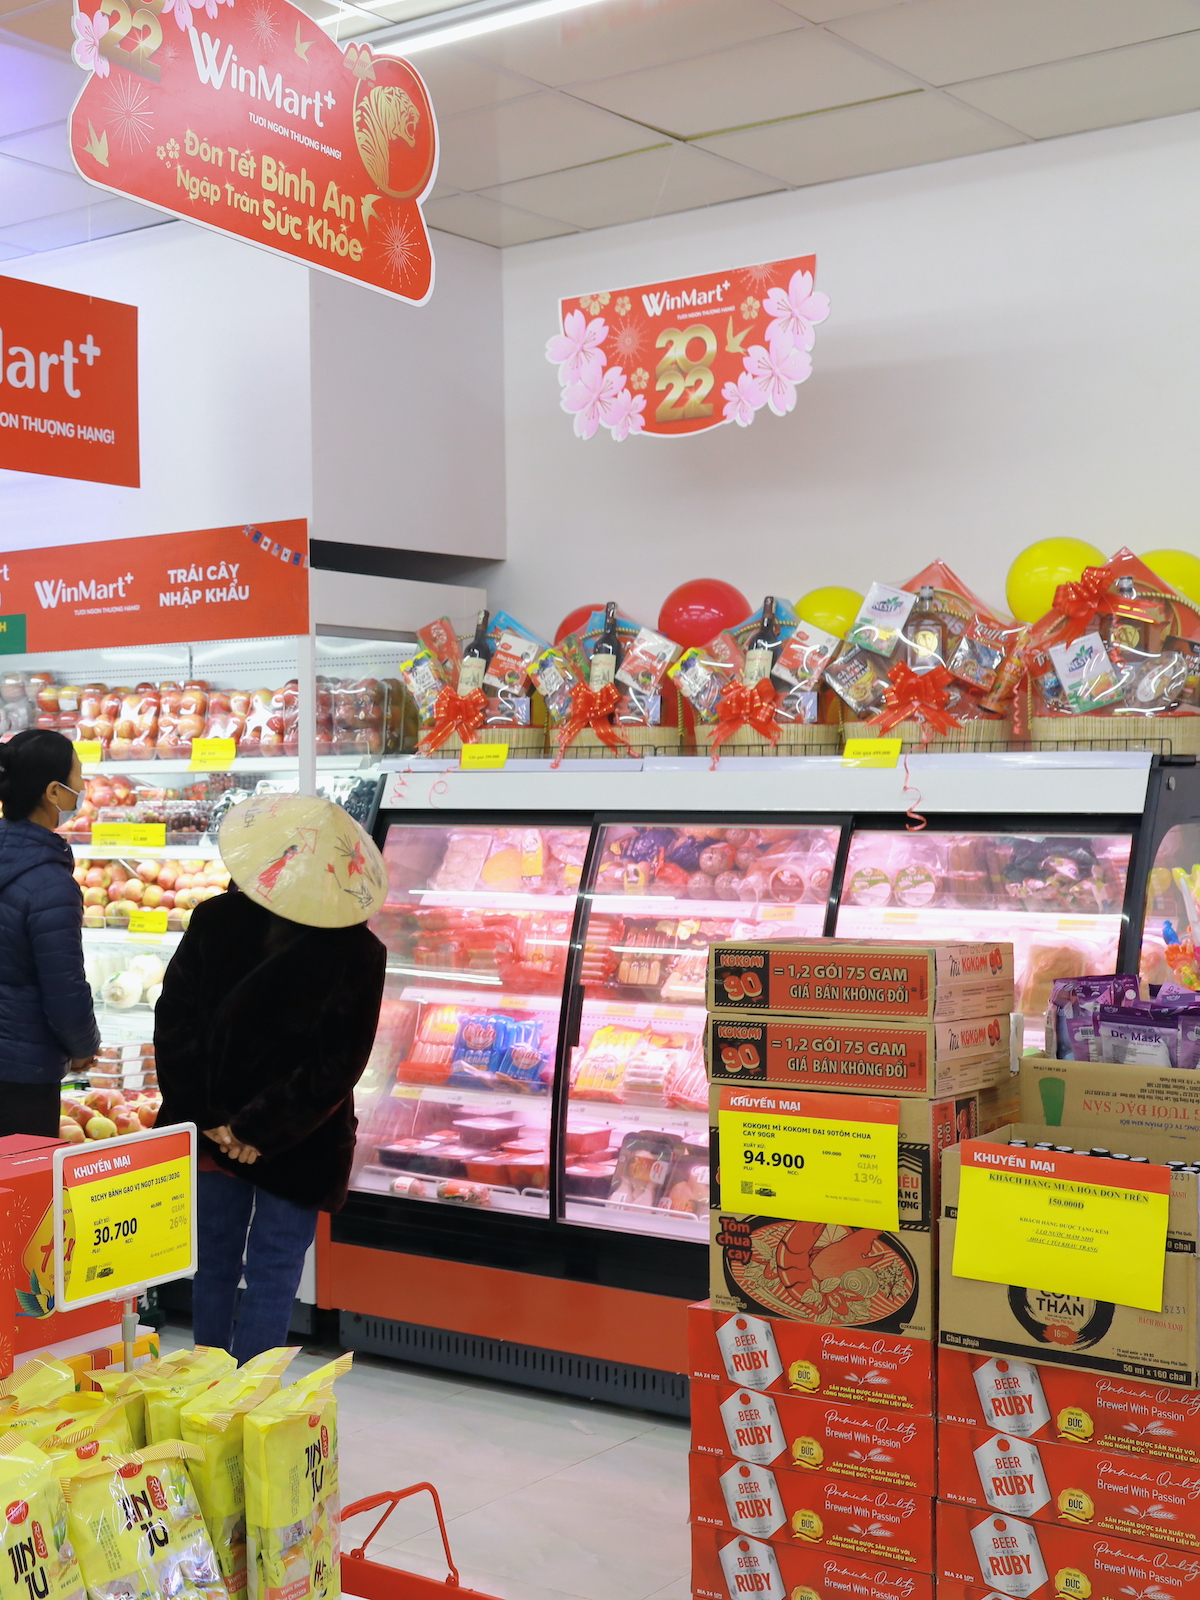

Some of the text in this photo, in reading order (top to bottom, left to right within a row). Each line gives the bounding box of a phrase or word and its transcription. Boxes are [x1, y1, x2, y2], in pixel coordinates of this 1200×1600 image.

[188, 26, 336, 128] WinMart+
[249, 112, 342, 161] TƯƠI NGON THƯỢNG HẠNG!
[184, 129, 355, 223] Đón Tết Bình An
[176, 165, 364, 262] Ngập Tràn Sức Khỏe
[641, 280, 731, 317] WinMart+
[655, 366, 715, 424] 22
[22, 415, 75, 439] THƯỢNG
[78, 425, 115, 445] HẠNG!
[167, 561, 240, 584] TRÁI CÂY
[34, 572, 134, 609] WinMart+
[159, 579, 250, 608] NHẬP KHẨU
[720, 954, 764, 968] KOKOMI
[787, 963, 908, 982] 1,2 GÓI 75 GAM
[723, 971, 763, 1001] 90
[790, 982, 909, 1003] GIÁ BÁN KHÔNG ĐỔI
[718, 1026, 762, 1040] KOKOMI
[1111, 1030, 1161, 1044] Dr. Mask
[730, 1094, 801, 1112] KHUYẾN MẠI
[1083, 1099, 1111, 1115] SẢN
[742, 1122, 770, 1130] KOKOMI
[773, 1123, 781, 1131] MÌ
[783, 1125, 811, 1134] KOKOMI
[812, 1127, 825, 1136] ĐẠI
[827, 1128, 850, 1138] 90TÔM
[742, 1130, 756, 1138] CAY
[73, 1154, 131, 1179] KHUYẾN MẠI
[743, 1150, 805, 1169] 94.900
[974, 1151, 1056, 1173] KHUYẾN MẠI
[854, 1172, 882, 1185] 13%
[989, 1172, 1022, 1184] KHÁCH
[1024, 1178, 1051, 1189] HÀNG
[1054, 1183, 1075, 1192] MUA
[1077, 1185, 1097, 1196] HÓA
[1123, 1192, 1149, 1203] TRÊN
[94, 1217, 137, 1246] 30.700
[170, 1215, 187, 1230] 26%
[721, 1218, 750, 1234] Tôm
[717, 1233, 750, 1247] chua
[727, 1250, 750, 1262] cay
[1036, 1298, 1084, 1317] THAN
[1164, 1305, 1186, 1315] 5231
[735, 1334, 757, 1348] BEER
[821, 1332, 914, 1365] Premium Quality
[732, 1350, 770, 1372] RUBY
[821, 1350, 898, 1370] Brewed With Passion
[994, 1377, 1021, 1391] BEER
[1123, 1364, 1186, 1383] 50 ml x 160 chai
[991, 1393, 1034, 1418] RUBY
[1096, 1397, 1185, 1422] Brewed With Passion
[305, 1439, 322, 1478] JIN
[8, 1537, 36, 1585] JIN
